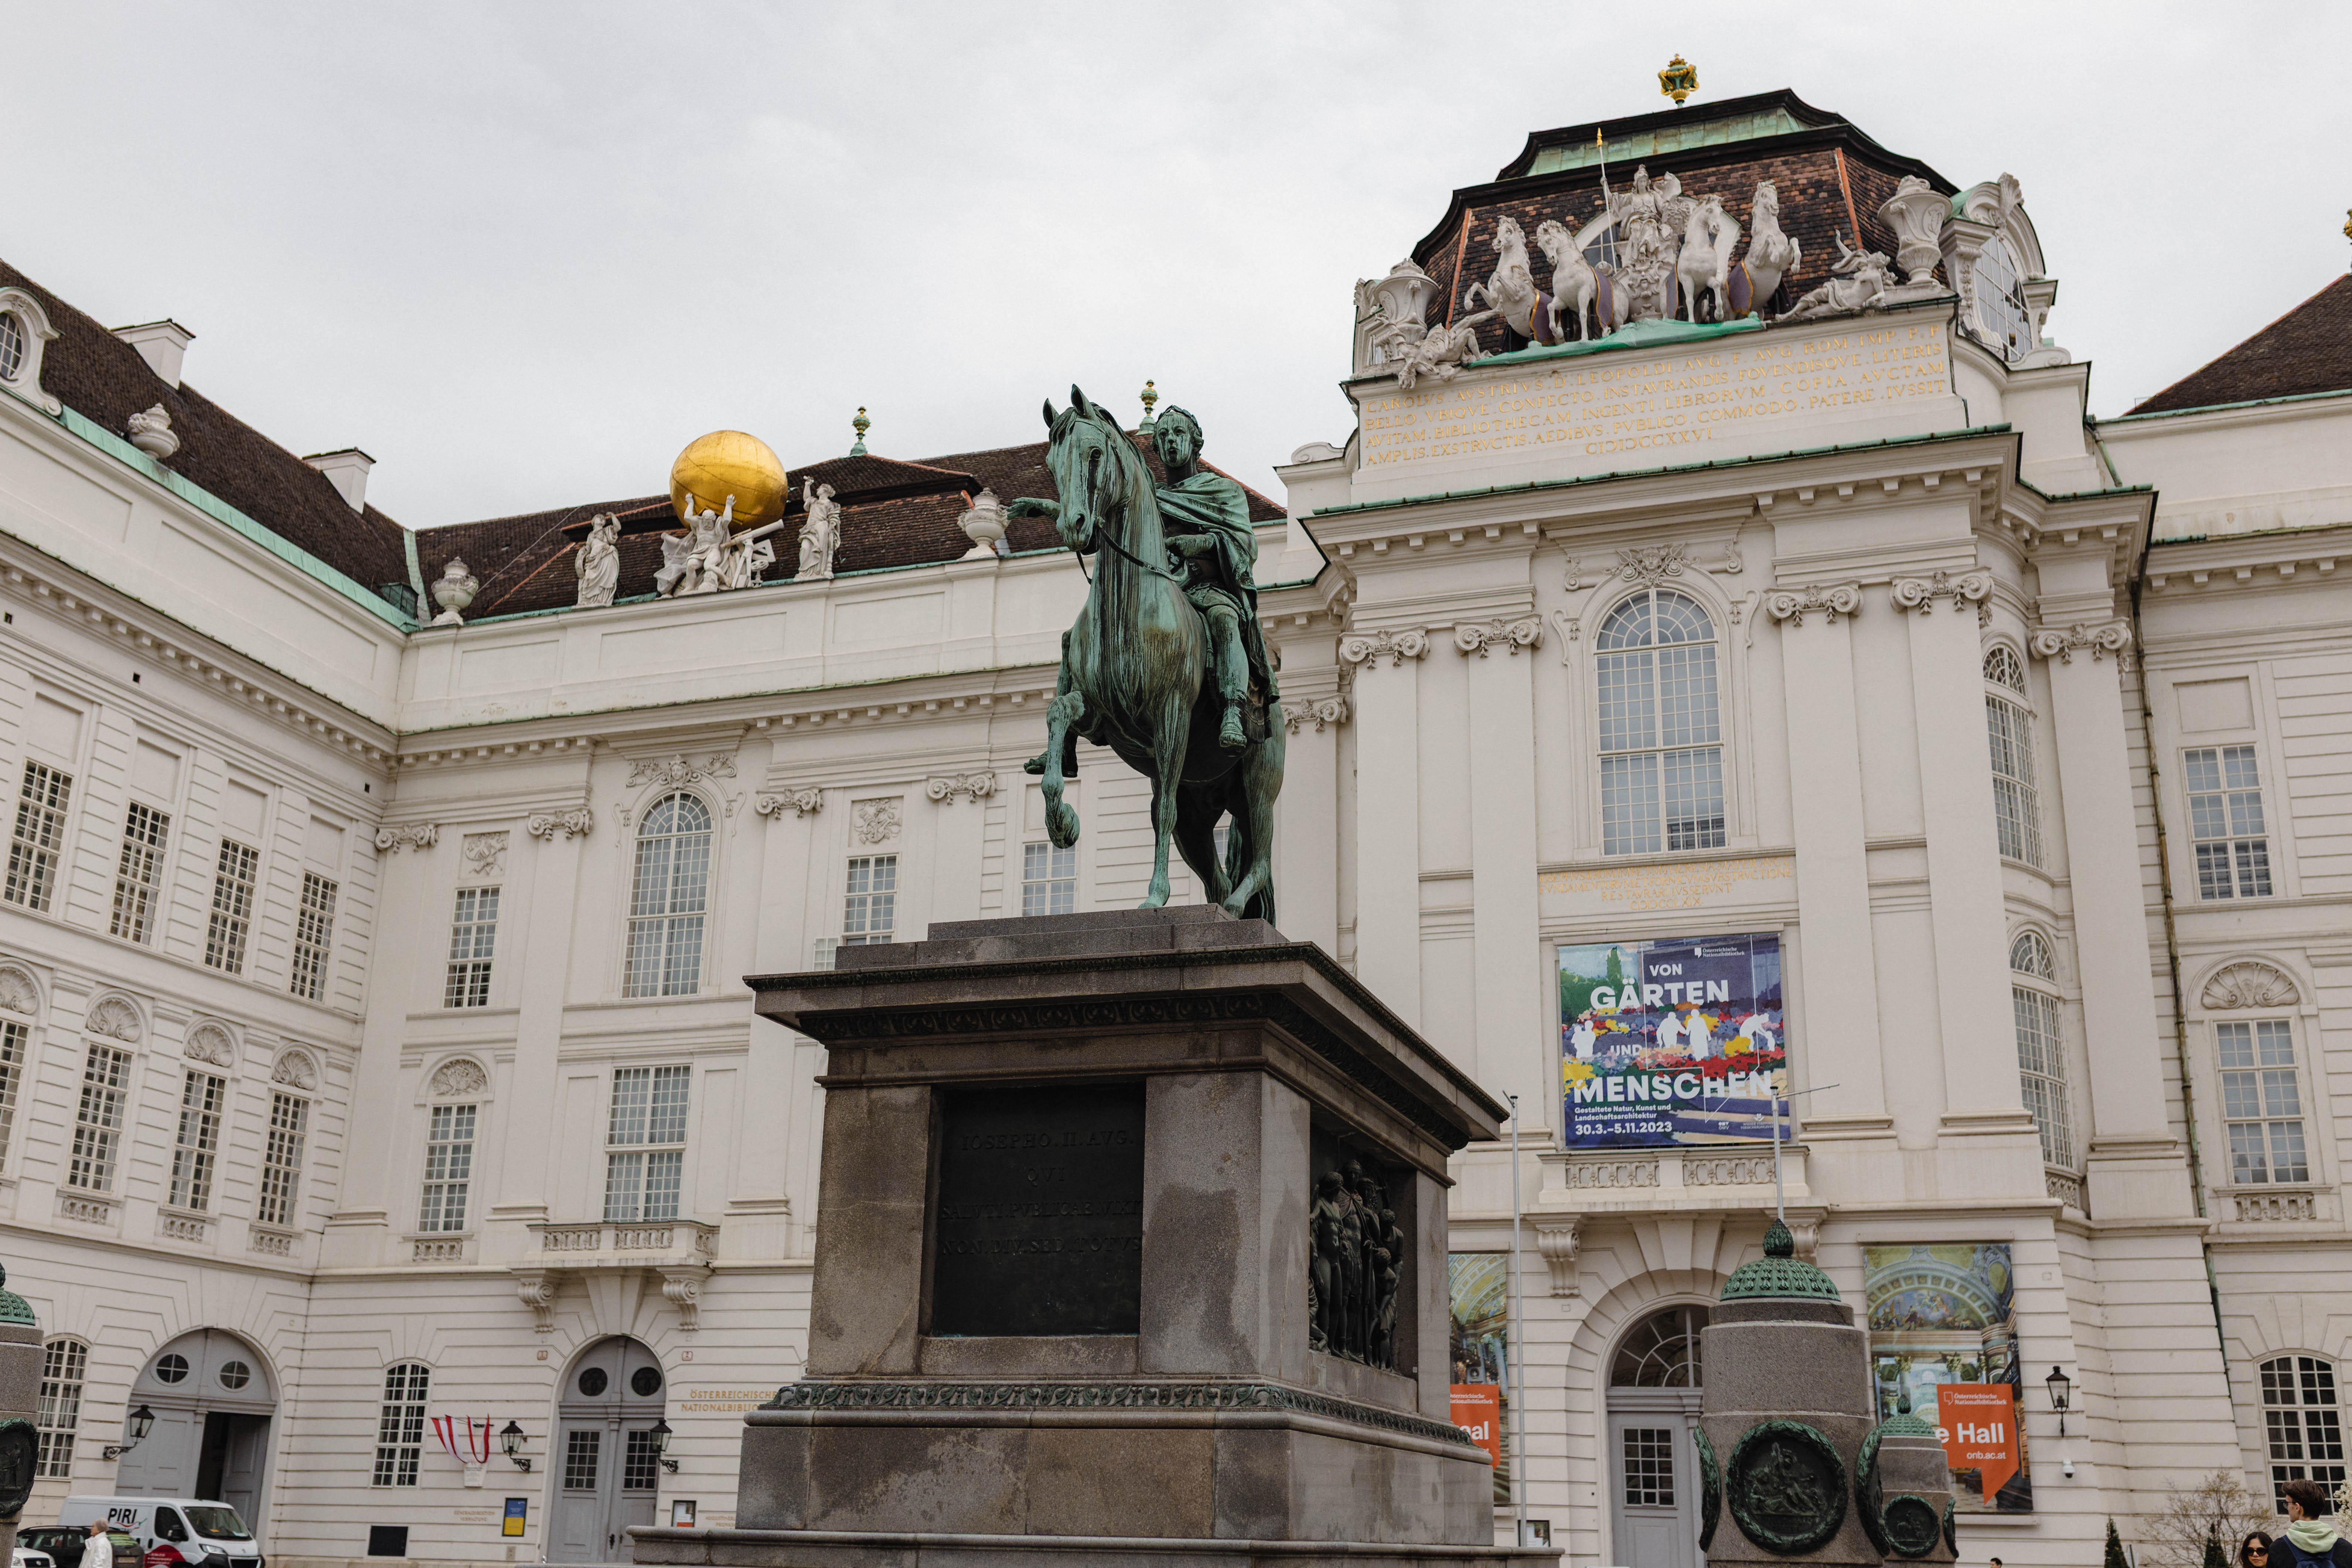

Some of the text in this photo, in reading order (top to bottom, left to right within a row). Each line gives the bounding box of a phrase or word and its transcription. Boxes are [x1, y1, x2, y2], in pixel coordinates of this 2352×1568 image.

[1873, 342, 1941, 364] LITERIS
[1860, 361, 1944, 384] AVCTAM
[1887, 379, 1946, 399] IVSSIT
[1649, 963, 1682, 976] VON
[1590, 978, 1729, 1009] GÄRTEN
[1610, 1044, 1642, 1057] UND
[1574, 1070, 1772, 1103] MENSCHEN
[1575, 1112, 1657, 1121] Landschaftsarchitektur
[1027, 1167, 1066, 1187] QVI
[1074, 1237, 1142, 1253] TOTVS
[1957, 1423, 2004, 1443] Hall
[108, 1508, 137, 1524] PIRI
